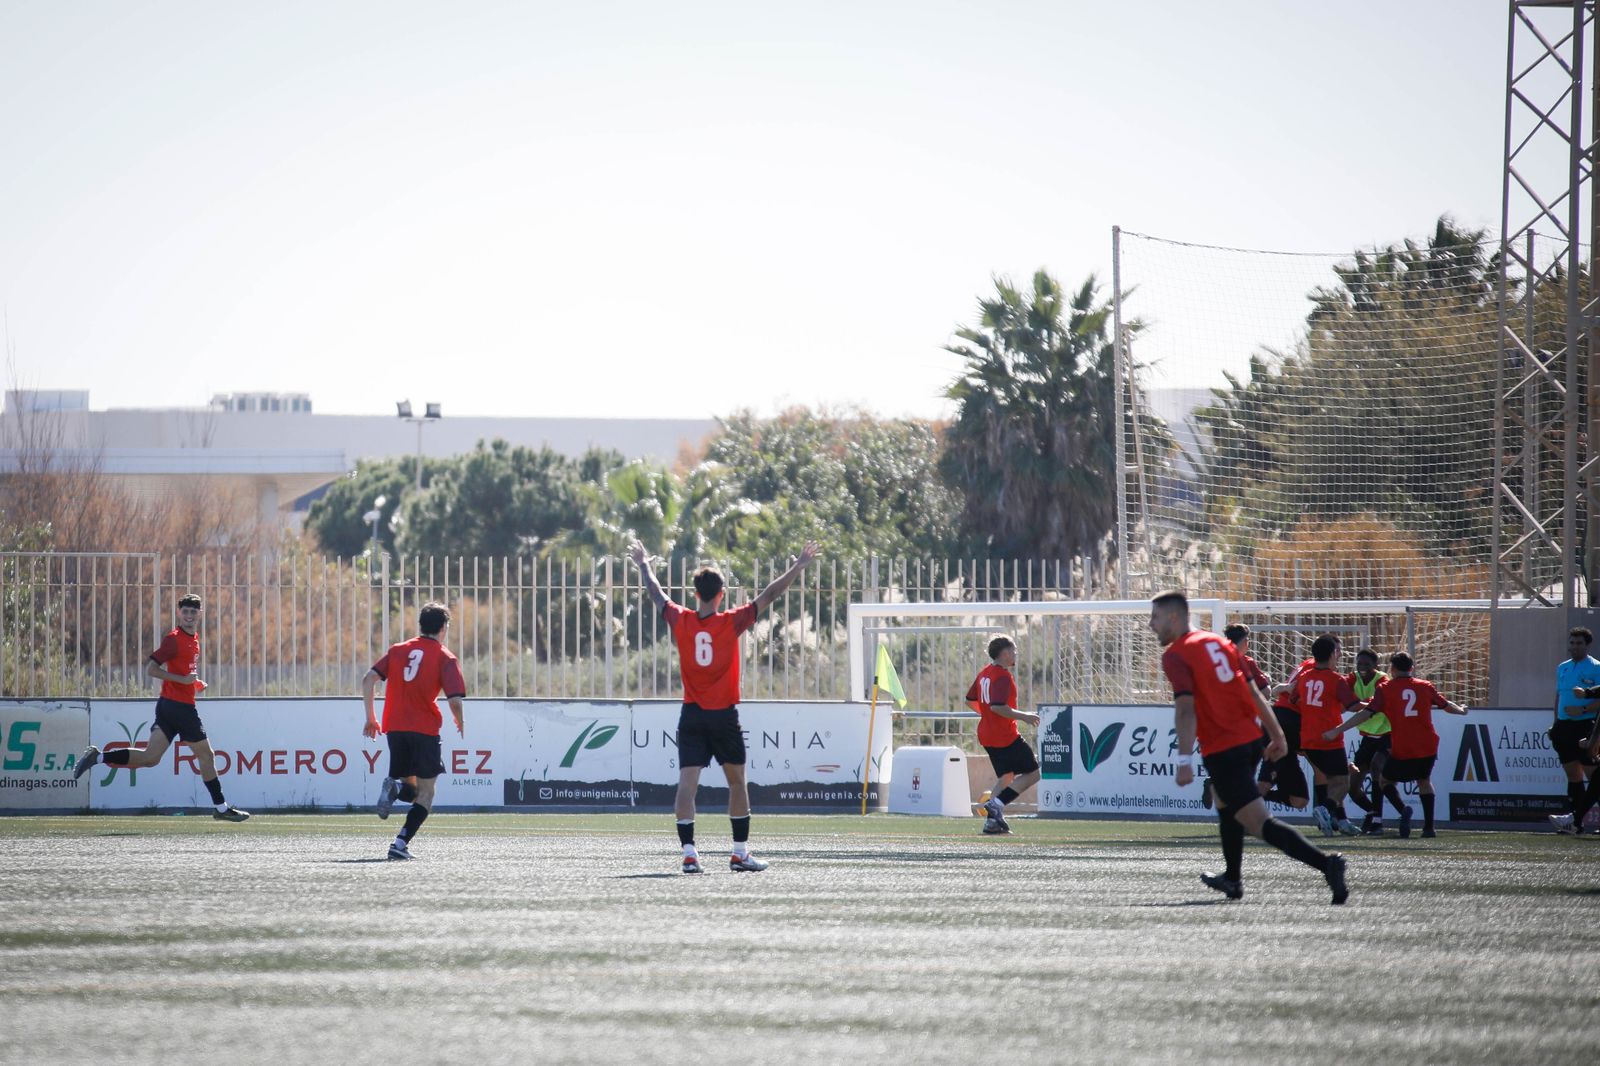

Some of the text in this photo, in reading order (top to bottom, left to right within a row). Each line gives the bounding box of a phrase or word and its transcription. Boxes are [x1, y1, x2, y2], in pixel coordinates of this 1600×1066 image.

[695, 631, 713, 667] 6
[1204, 641, 1234, 683] 5
[404, 649, 424, 682] 3
[980, 677, 991, 704] 10
[1305, 679, 1325, 707] 12
[1402, 689, 1418, 717] 2
[1044, 743, 1069, 753] nuestra
[1129, 726, 1157, 757] El
[1044, 753, 1062, 762] meta
[1513, 757, 1563, 769] ASOCIADO
[555, 788, 640, 800] info@unigenia.com
[780, 790, 878, 800] www.unigenia.com
